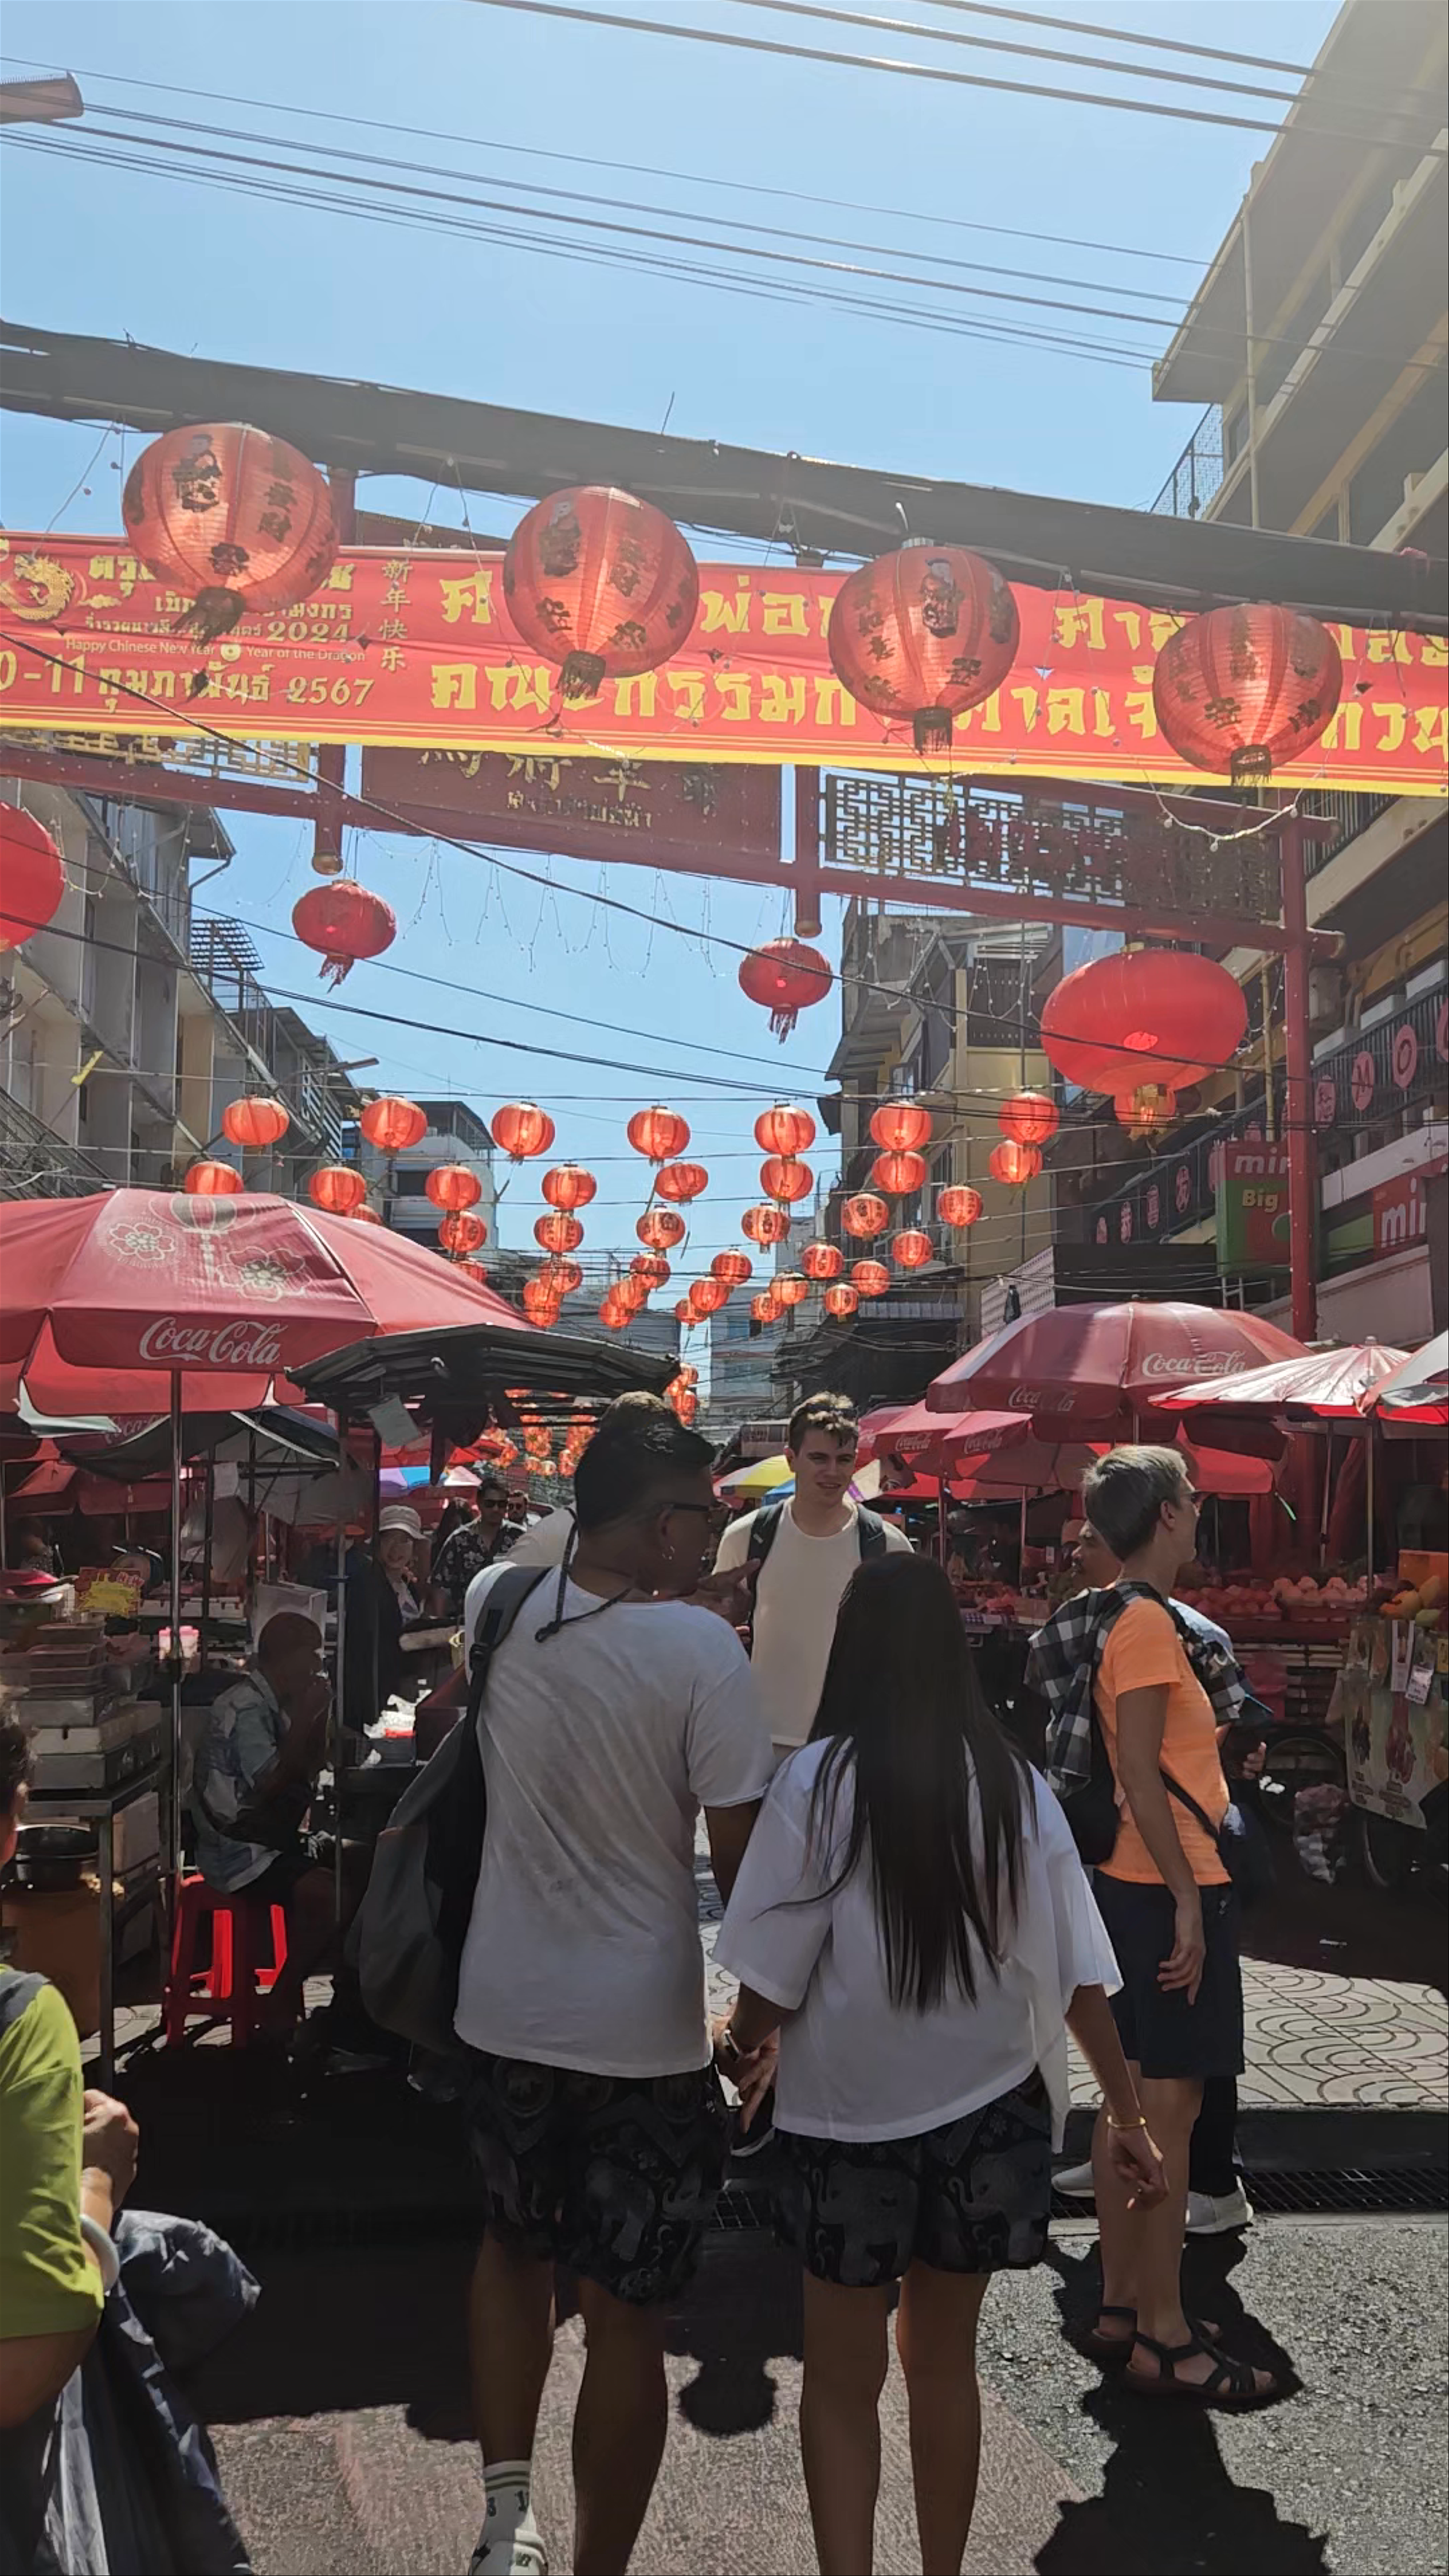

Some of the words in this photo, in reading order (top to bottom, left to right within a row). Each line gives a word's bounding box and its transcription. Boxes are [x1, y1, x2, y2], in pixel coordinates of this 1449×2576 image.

[378, 559, 413, 672] 新年快乐
[267, 621, 349, 643] 2024
[66, 638, 106, 654] Happy
[109, 640, 156, 654] Chinese
[160, 642, 186, 654] New
[190, 643, 215, 655] Year
[246, 646, 275, 658] Year
[277, 646, 290, 658] of
[294, 647, 314, 660] the
[318, 649, 365, 663] Dragon
[288, 676, 375, 706] 2567
[1242, 1189, 1278, 1213] Big
[139, 1316, 288, 1365] Coca-Cola
